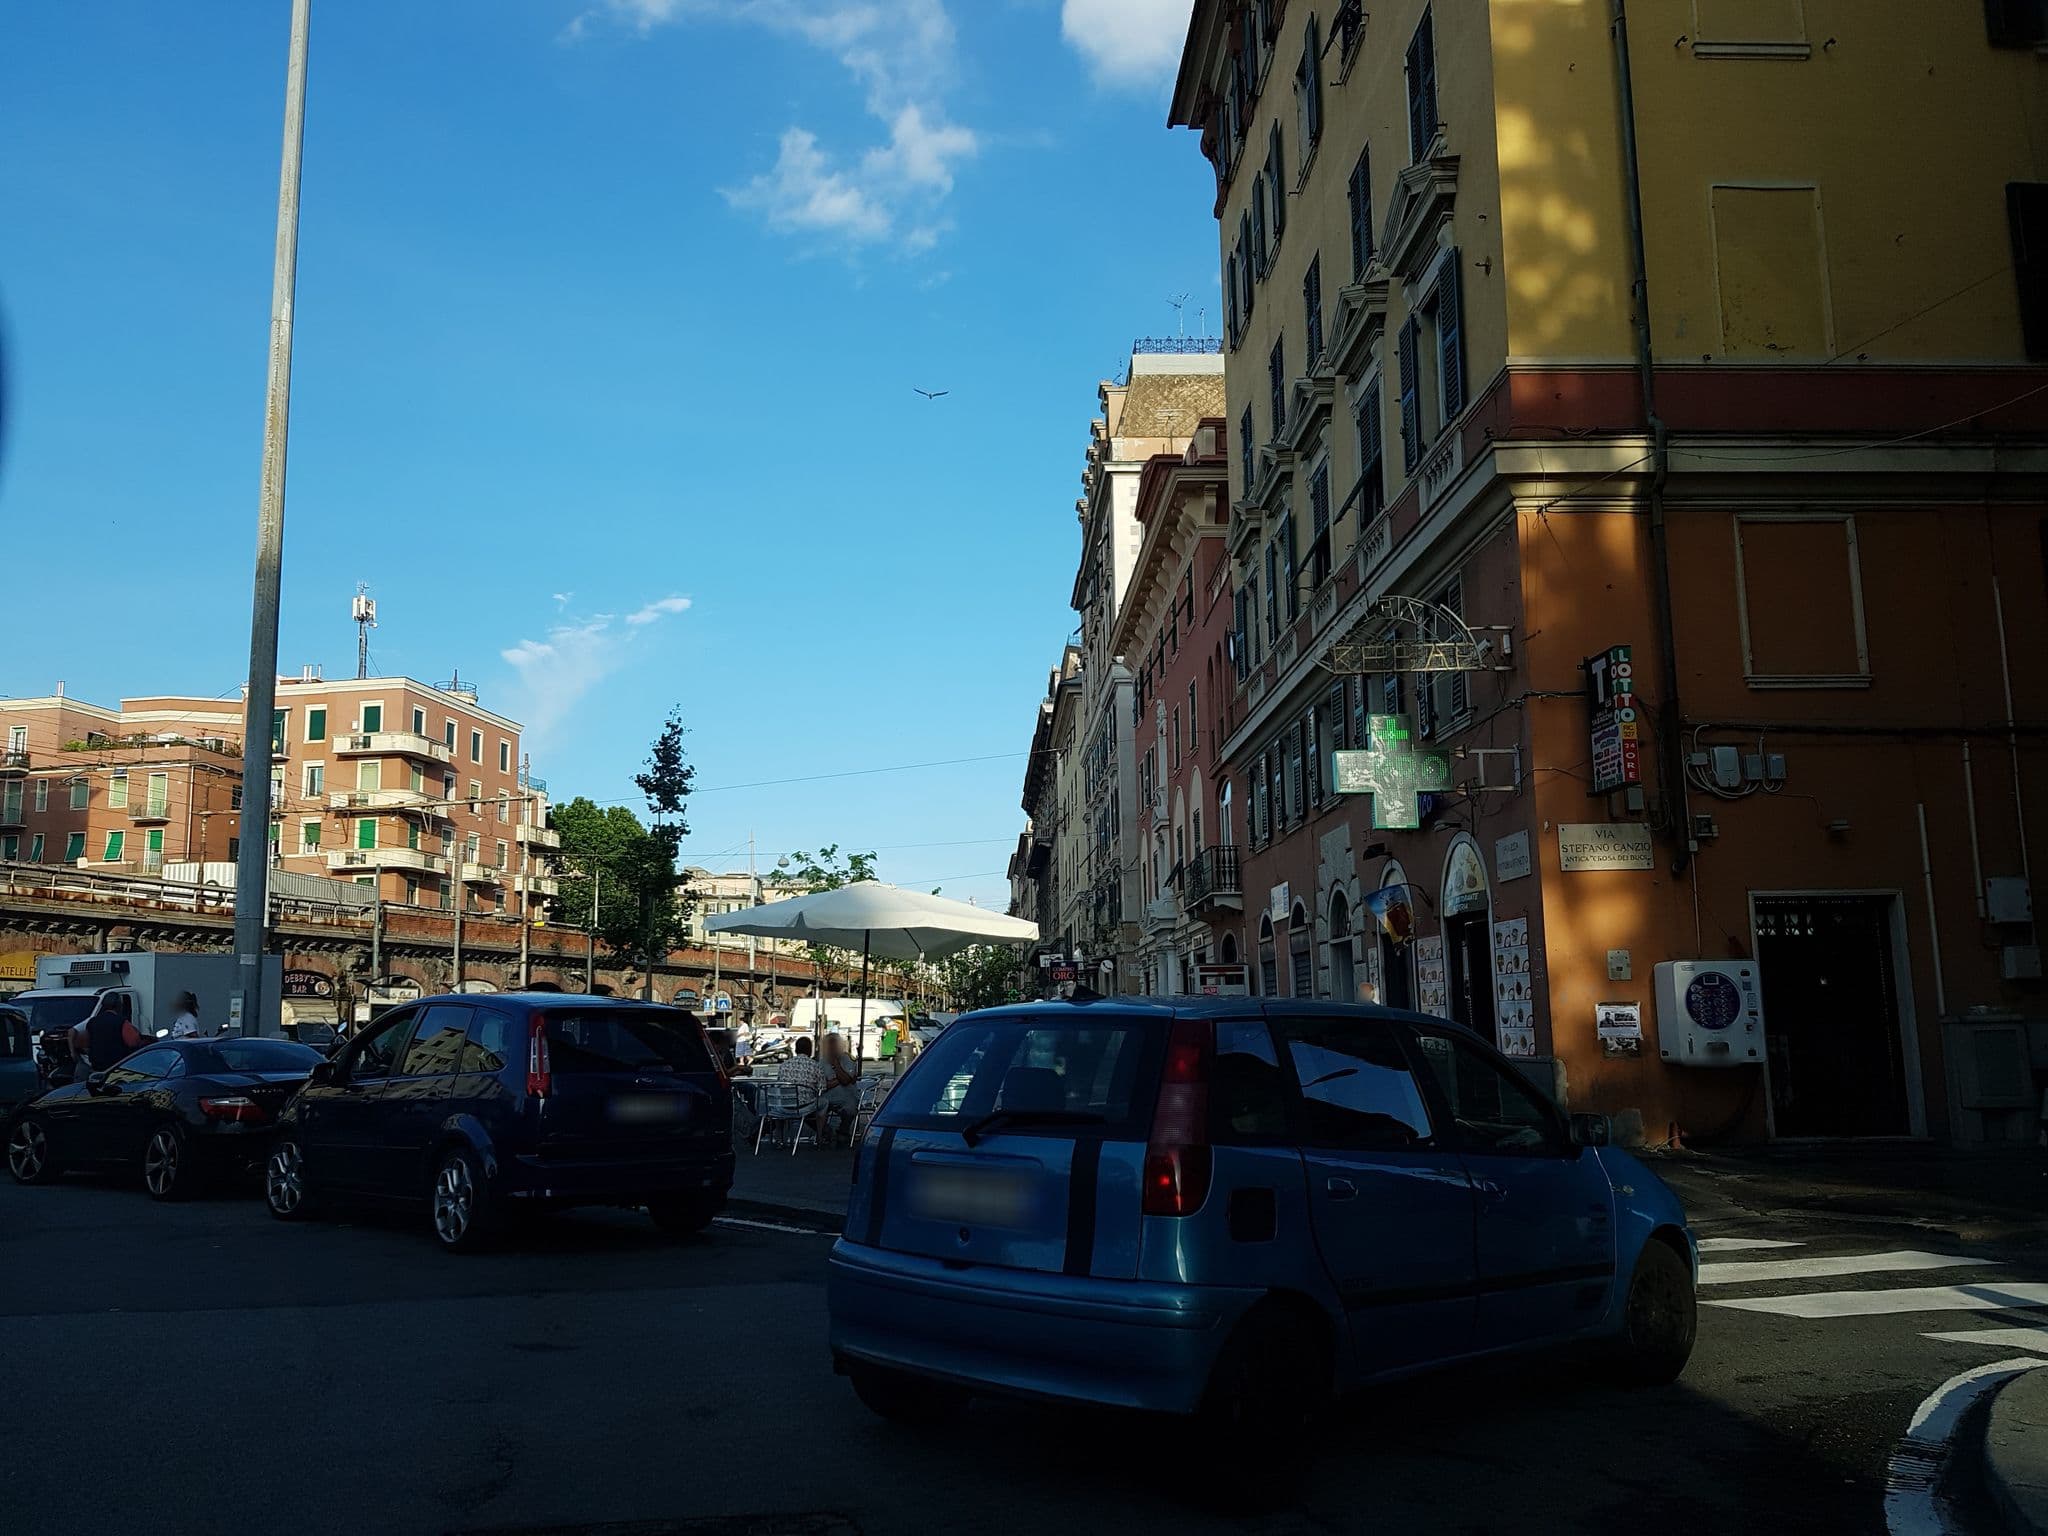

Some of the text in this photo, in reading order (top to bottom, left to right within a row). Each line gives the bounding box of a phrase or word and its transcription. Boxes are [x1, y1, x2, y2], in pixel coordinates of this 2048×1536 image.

[1591, 656, 1607, 704] T
[1617, 649, 1635, 723] LOTTO
[1625, 752, 1637, 779] ORE
[1595, 829, 1615, 839] VIA
[1562, 842, 1651, 853] STEFANO CANZIO
[1566, 855, 1589, 863] ANTICA
[284, 973, 315, 984] DEBBY'S
[1052, 971, 1075, 980] ORO
[291, 984, 307, 994] BAR
